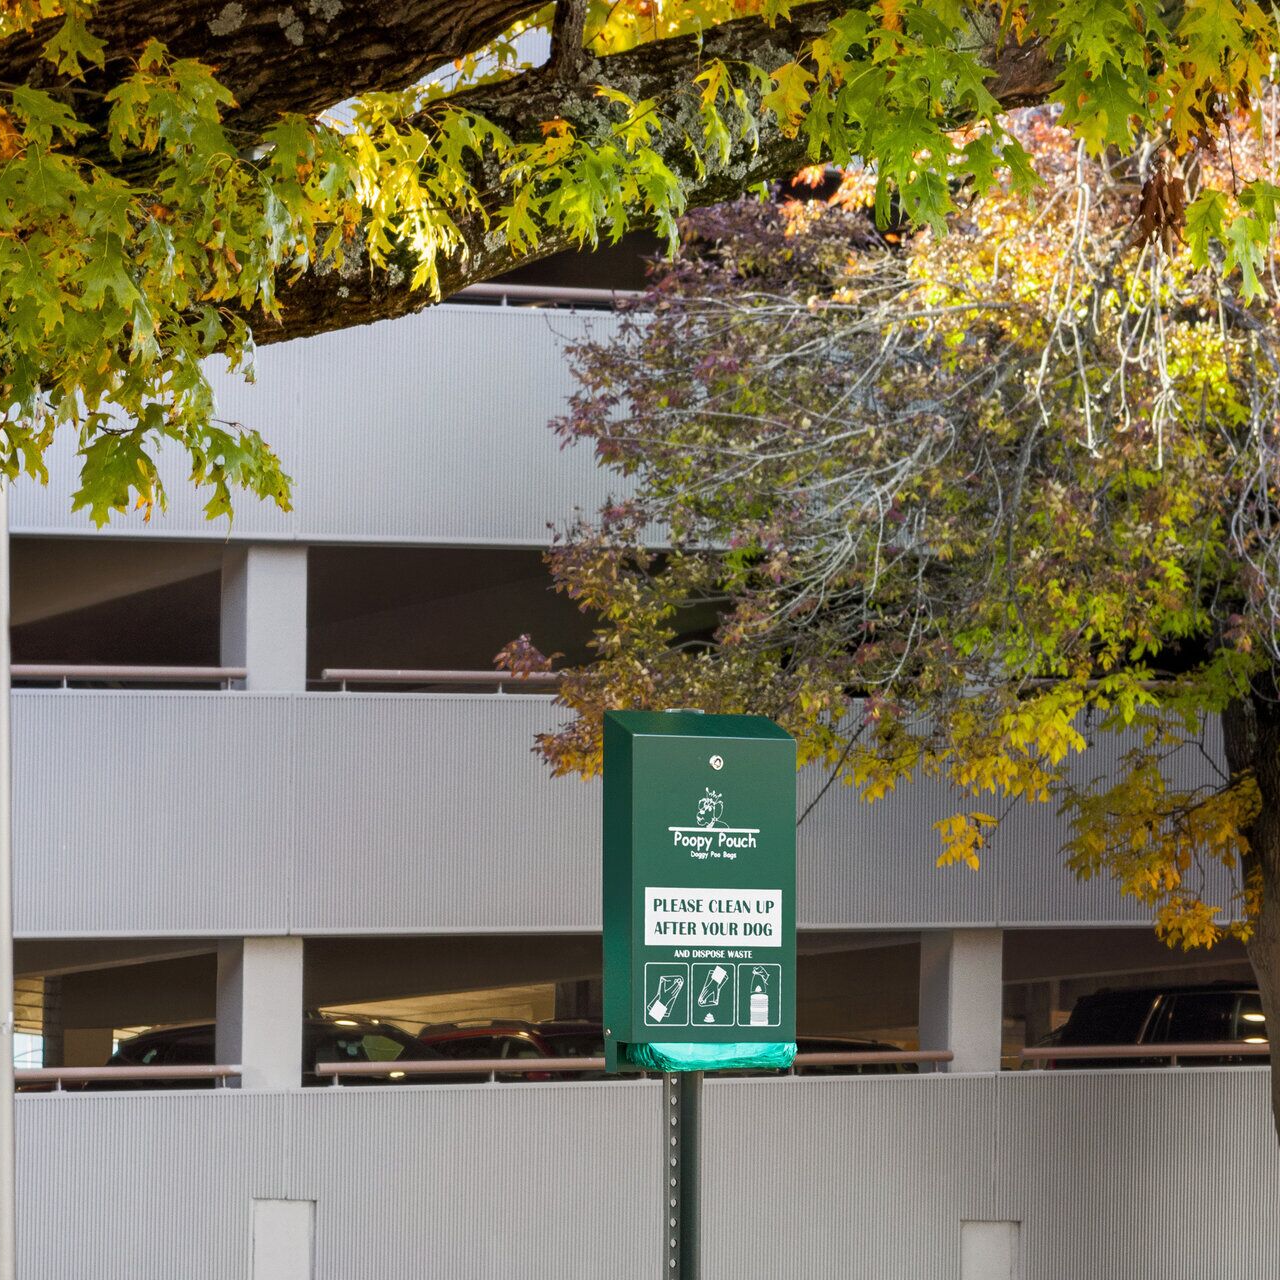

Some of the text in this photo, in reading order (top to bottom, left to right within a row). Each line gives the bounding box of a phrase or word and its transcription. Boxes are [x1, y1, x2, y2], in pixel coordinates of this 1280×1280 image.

[674, 831, 757, 851] Poopy Pouch
[690, 851, 708, 859] Doggy
[723, 851, 737, 860] Bags
[653, 899, 774, 914] PLEASE CLEAN UP
[654, 921, 773, 936] AFTER YOUR DOG
[673, 949, 753, 959] AND DISPOSE WASTE
